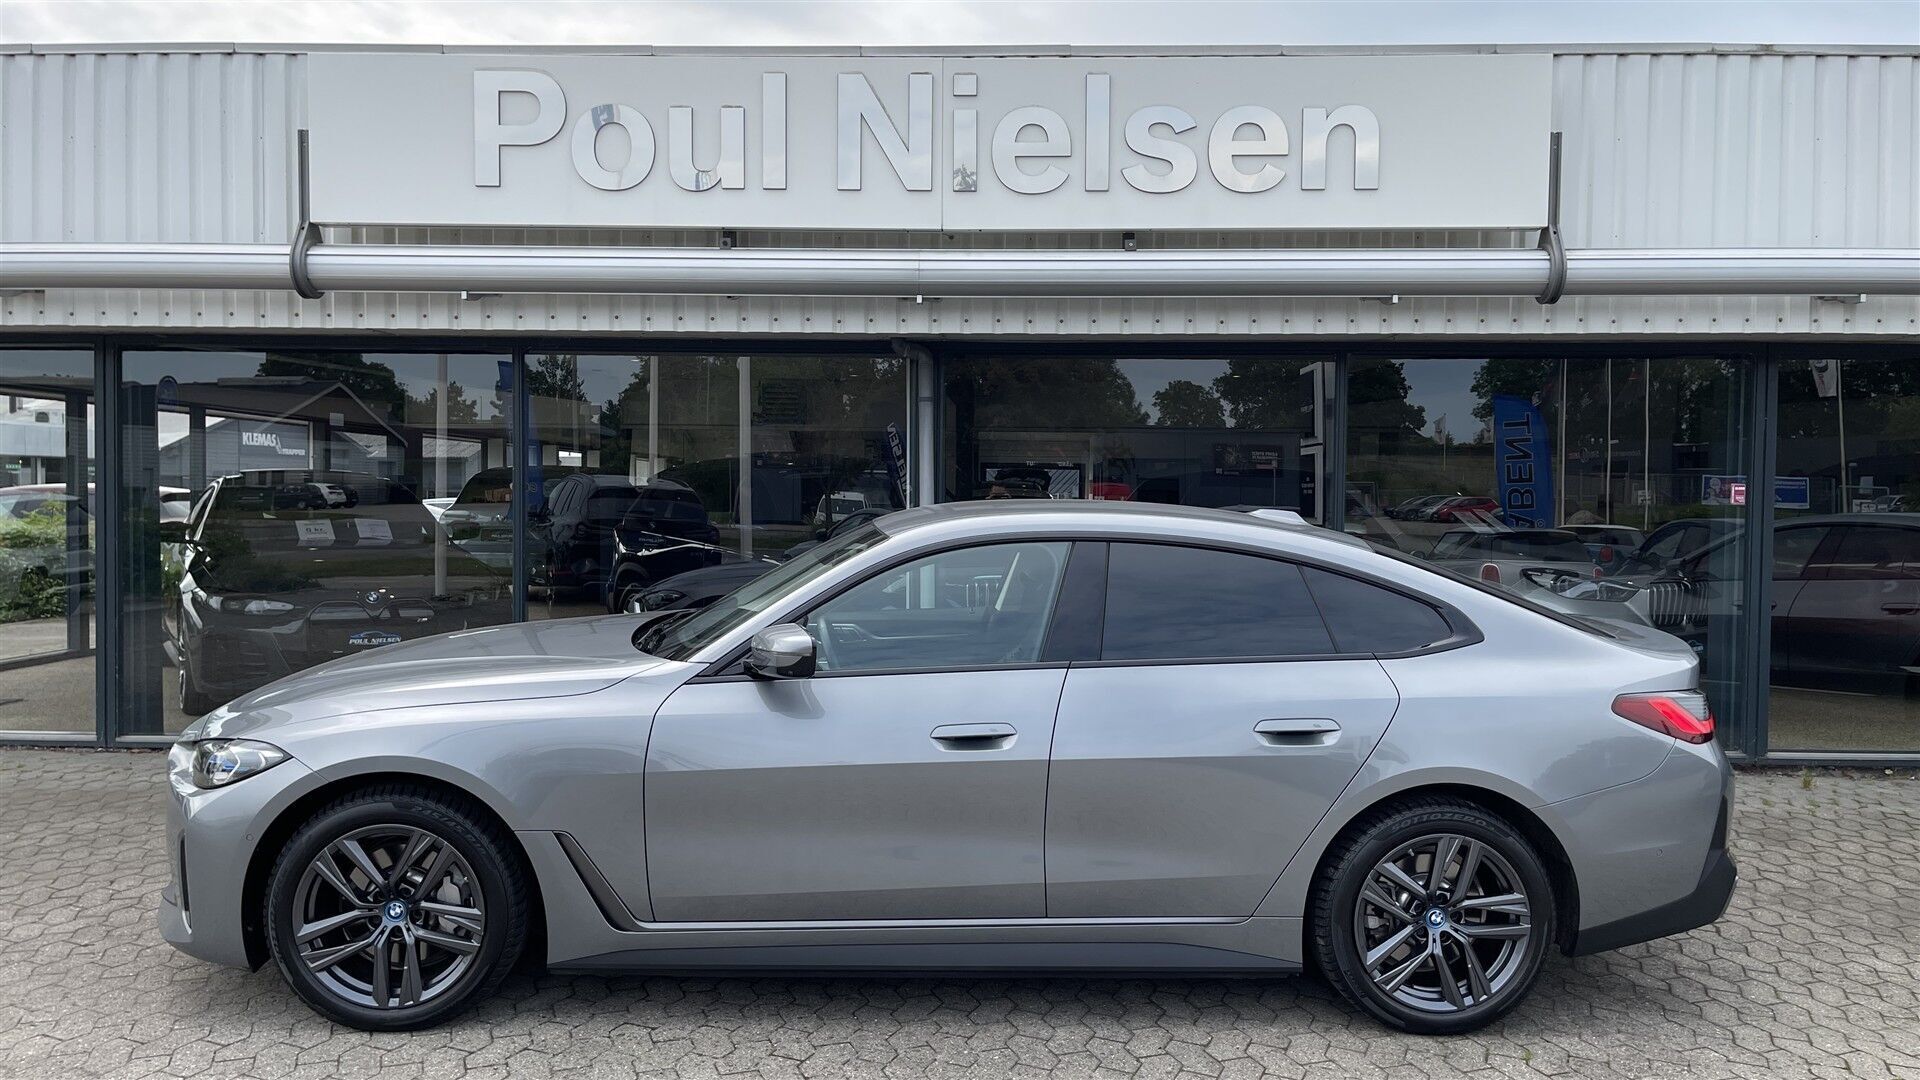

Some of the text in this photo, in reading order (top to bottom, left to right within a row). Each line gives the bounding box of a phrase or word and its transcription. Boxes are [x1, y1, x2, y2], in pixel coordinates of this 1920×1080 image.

[474, 68, 1380, 194] Poul Nielsen
[242, 432, 277, 447] KLEMAS
[370, 636, 402, 645] NIELSEN
